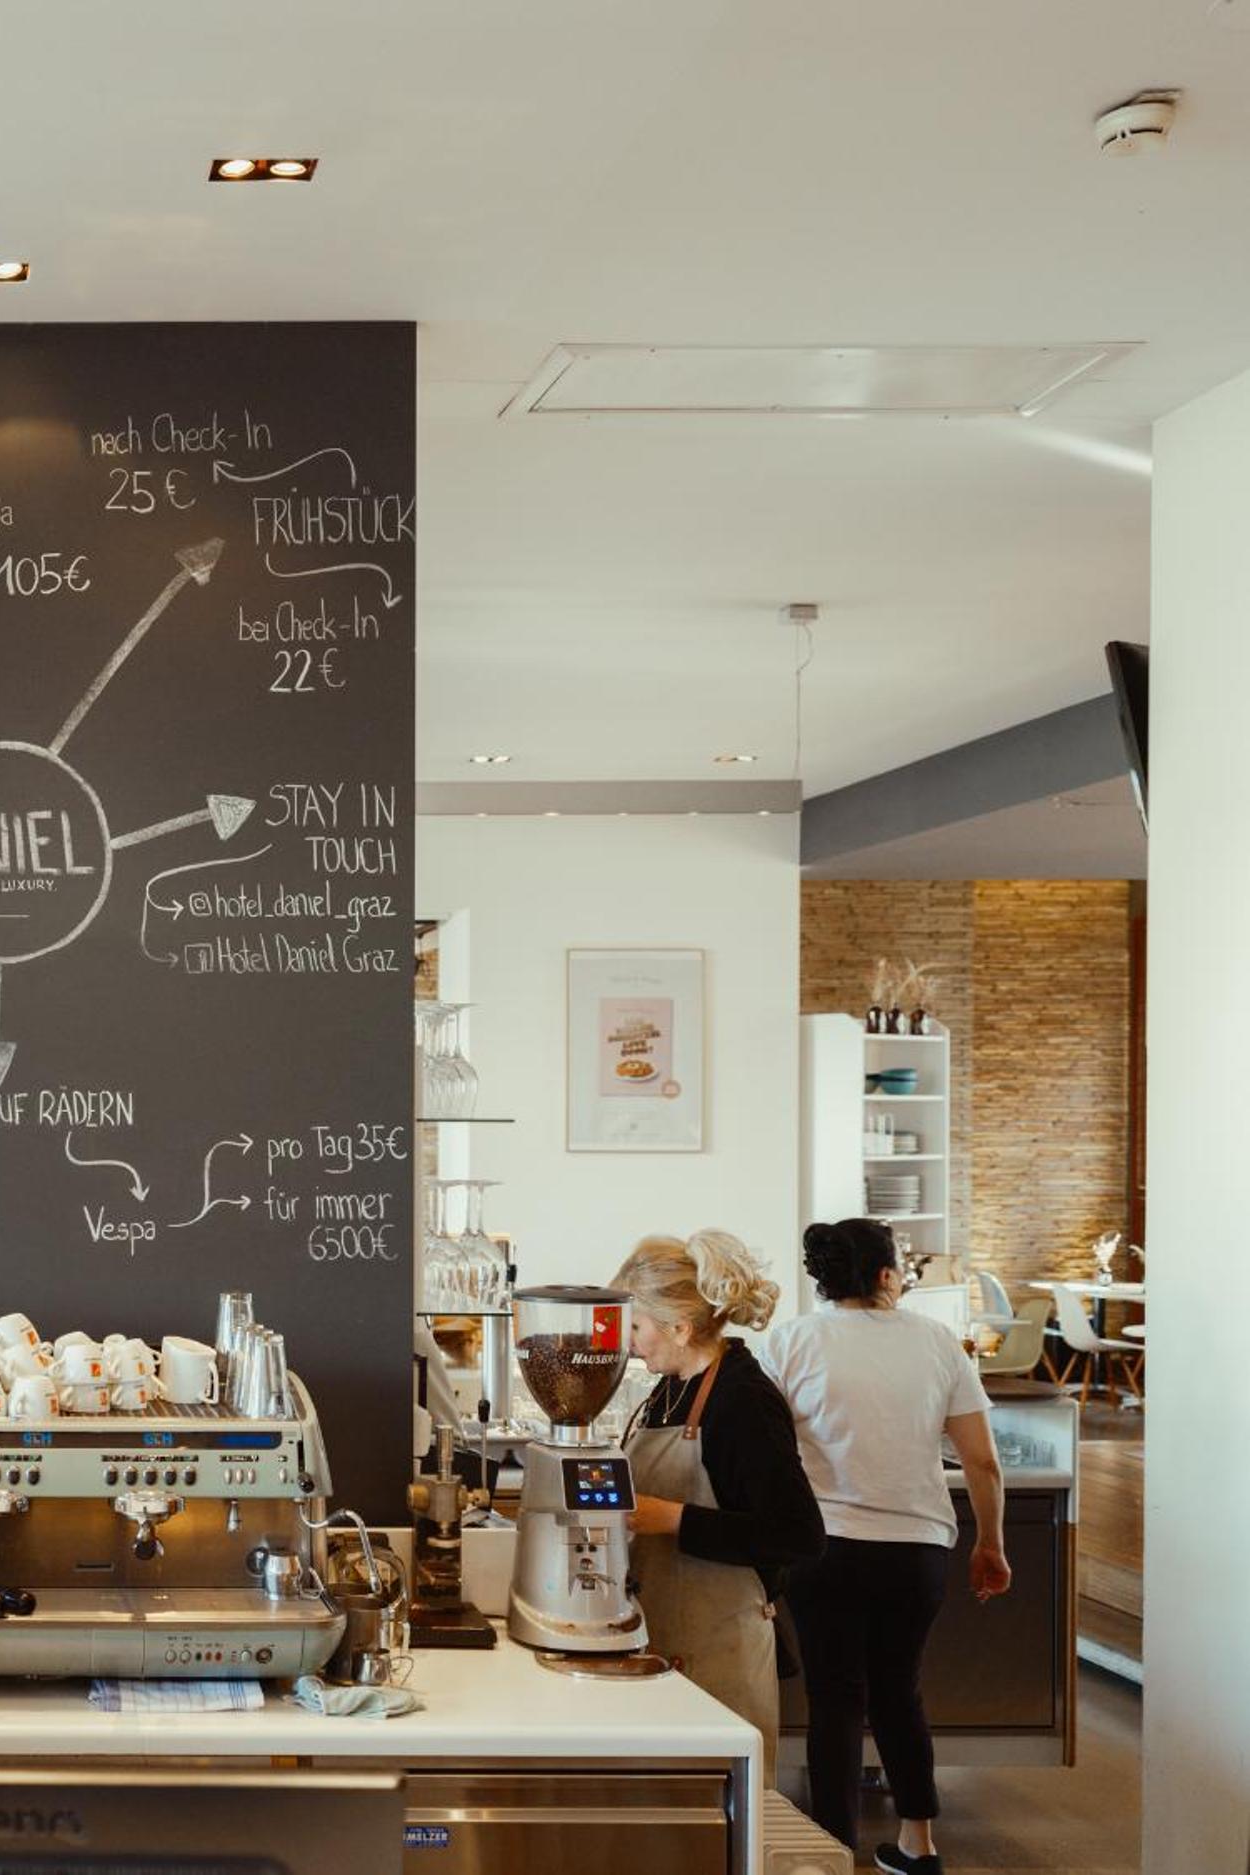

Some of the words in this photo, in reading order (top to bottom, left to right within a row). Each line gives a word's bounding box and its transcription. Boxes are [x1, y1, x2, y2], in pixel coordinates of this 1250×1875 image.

[91, 416, 141, 455] nach
[152, 409, 272, 455] Check-In
[238, 605, 270, 642] bei
[276, 596, 380, 642] Check-In
[265, 783, 344, 828] STAY
[361, 784, 396, 828] IN
[304, 836, 397, 876] TOUCH
[215, 880, 396, 934] hotel_daniel_graz
[217, 935, 270, 974] Hotel
[276, 936, 338, 976] Daniel
[344, 935, 400, 975] Graz
[39, 1085, 134, 1128] RÄDERN
[266, 1138, 303, 1177] pro
[310, 1126, 353, 1174] Tag
[354, 1123, 408, 1161] 35€
[263, 1186, 301, 1221] für
[315, 1186, 392, 1220] immer
[83, 1205, 157, 1257] Vespa
[307, 1224, 399, 1261] 6500€
